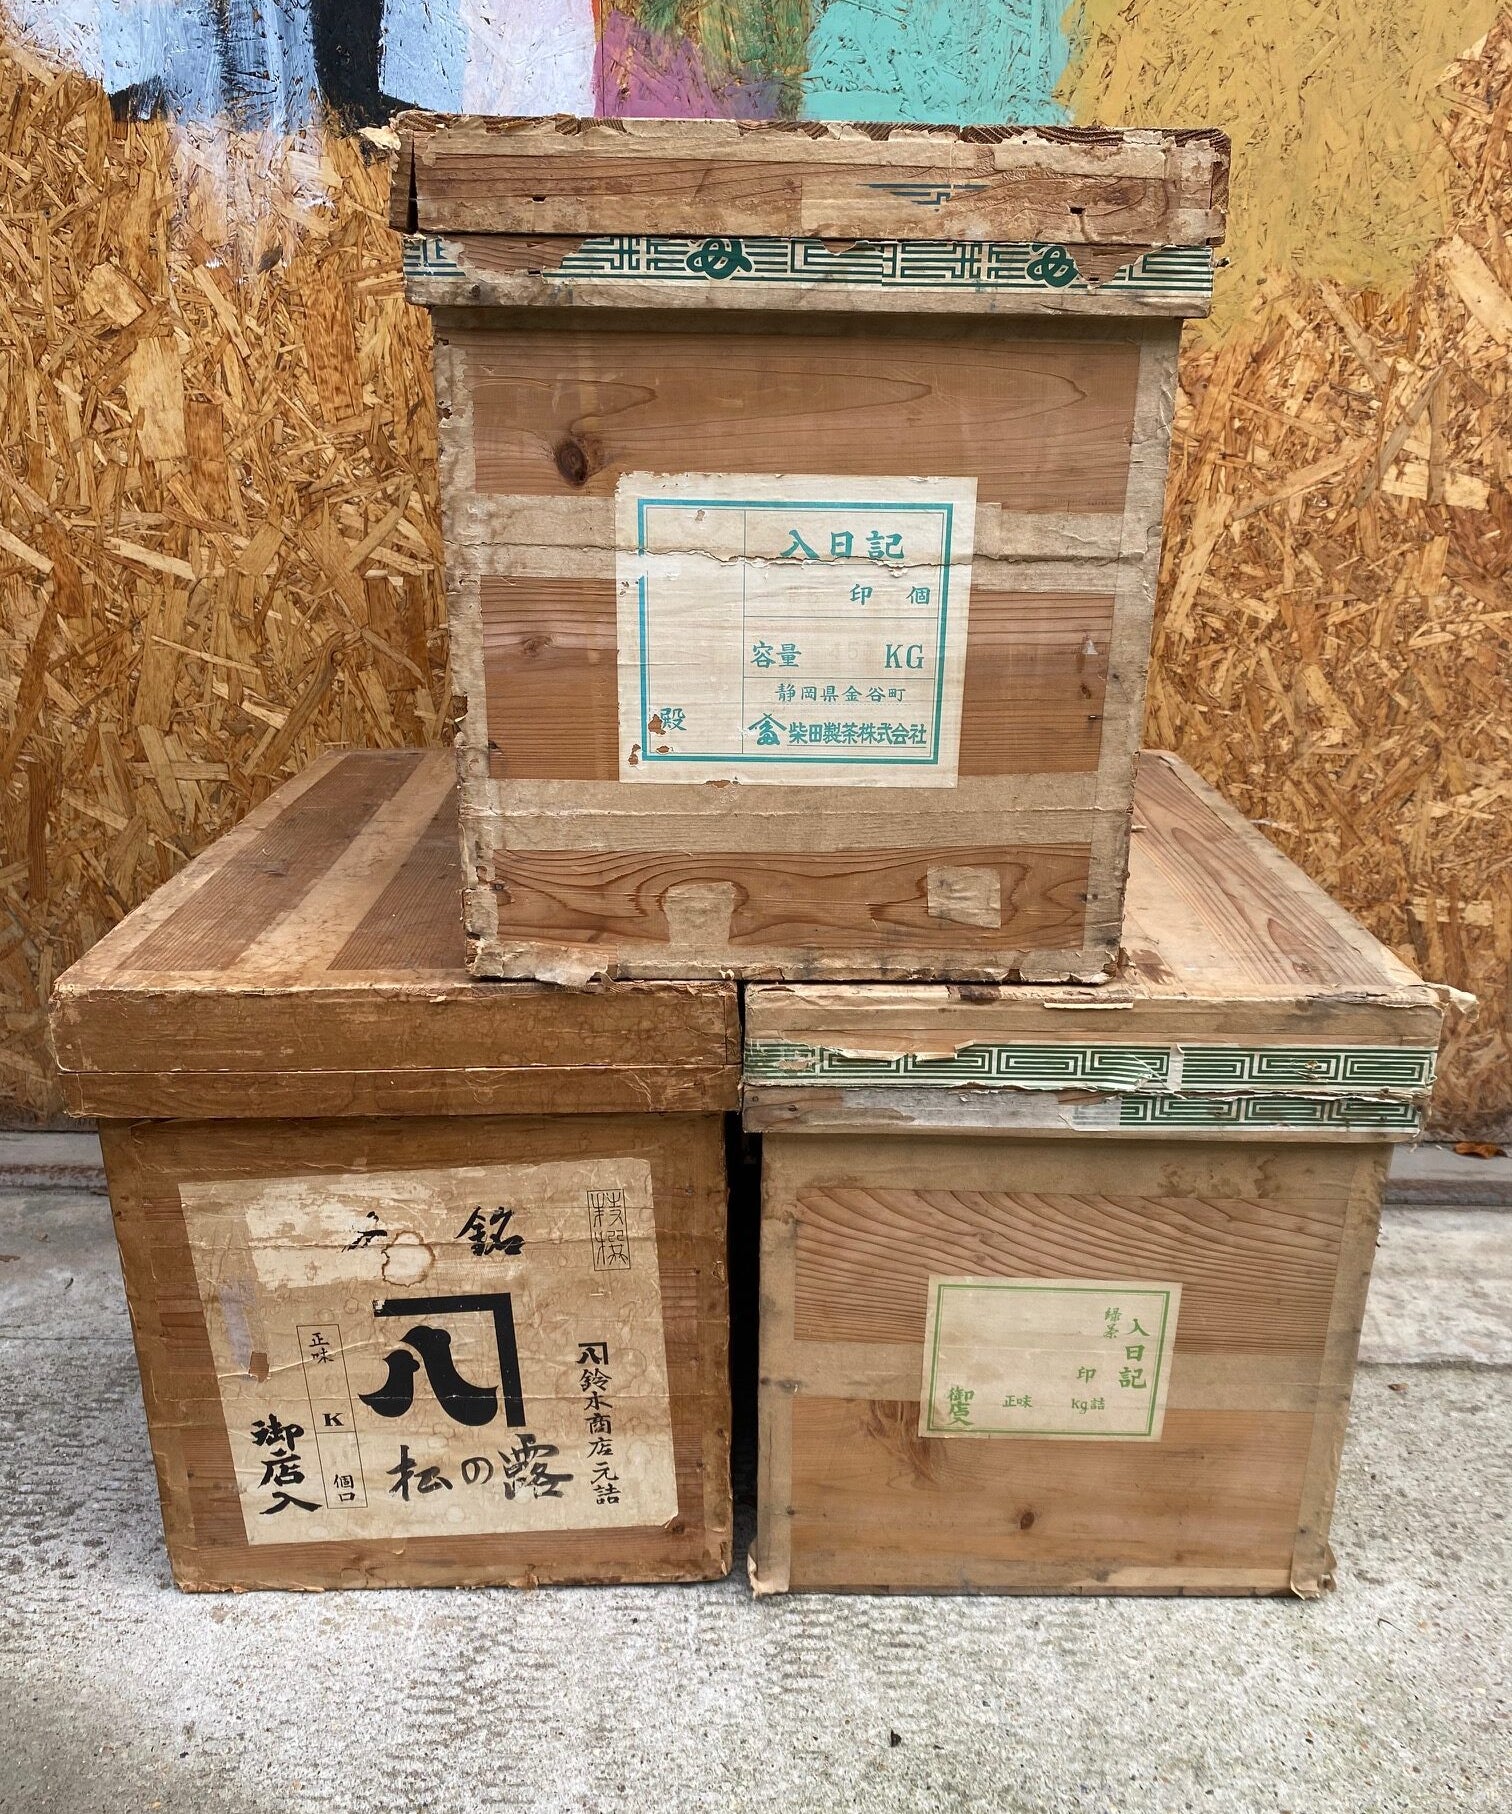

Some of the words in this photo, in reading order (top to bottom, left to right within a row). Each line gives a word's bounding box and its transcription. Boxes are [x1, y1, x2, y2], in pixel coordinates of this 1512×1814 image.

[780, 529, 905, 559] 入日記
[850, 583, 873, 605] 印
[906, 586, 930, 605] 個
[750, 640, 802, 669] 容量
[884, 643, 924, 669] KG
[775, 683, 906, 702] 静岡県金谷町
[788, 721, 927, 745] 柴田製茶株式会社
[309, 1332, 334, 1364] 正味
[1118, 1318, 1151, 1389] 入日記
[1076, 1366, 1097, 1384] 印
[1002, 1394, 1032, 1409] 正味
[321, 1412, 345, 1427] K
